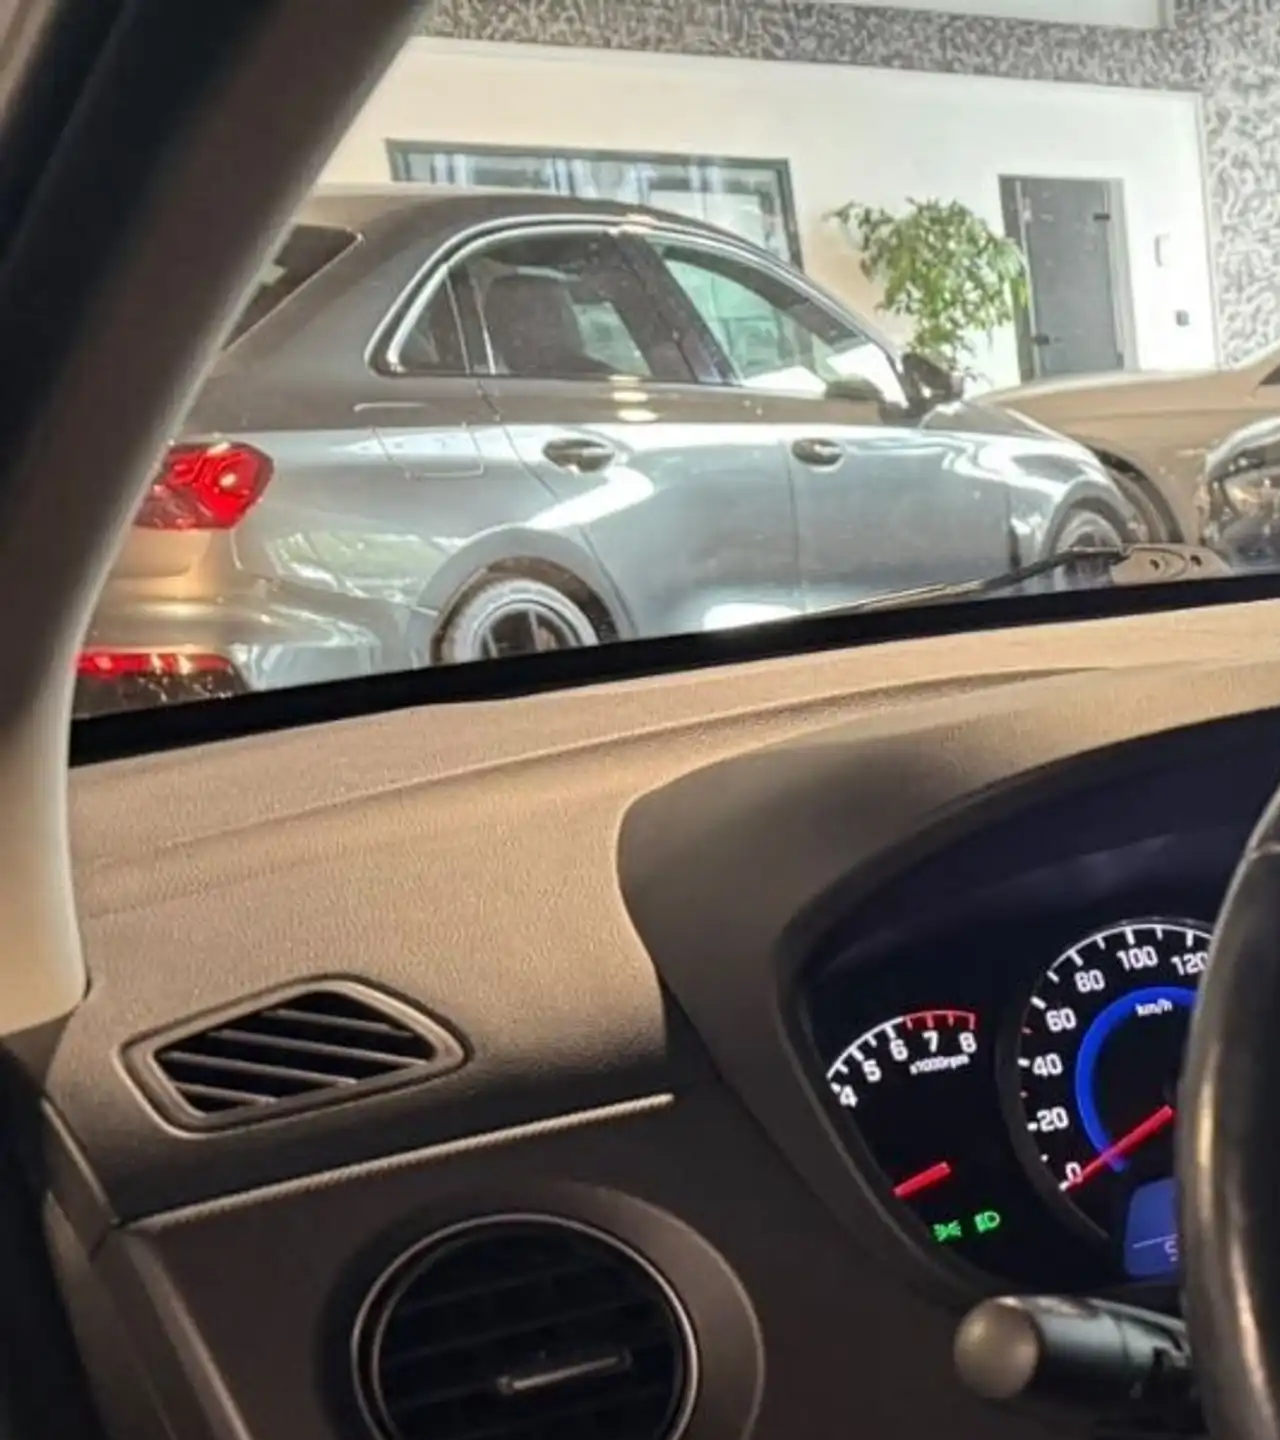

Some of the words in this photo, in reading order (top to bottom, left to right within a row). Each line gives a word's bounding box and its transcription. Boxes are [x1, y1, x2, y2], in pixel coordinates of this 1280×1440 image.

[1116, 945, 1158, 971] 100
[1170, 952, 1209, 976] 120
[1135, 998, 1173, 1017] km/h
[1045, 1007, 1077, 1033] 60
[889, 1038, 908, 1062] 6
[921, 1029, 939, 1053] 7
[958, 1031, 977, 1054] 8
[862, 1058, 882, 1082] 5
[1032, 1053, 1063, 1077] 40
[839, 1084, 858, 1108] 4
[1036, 1105, 1070, 1132] 20
